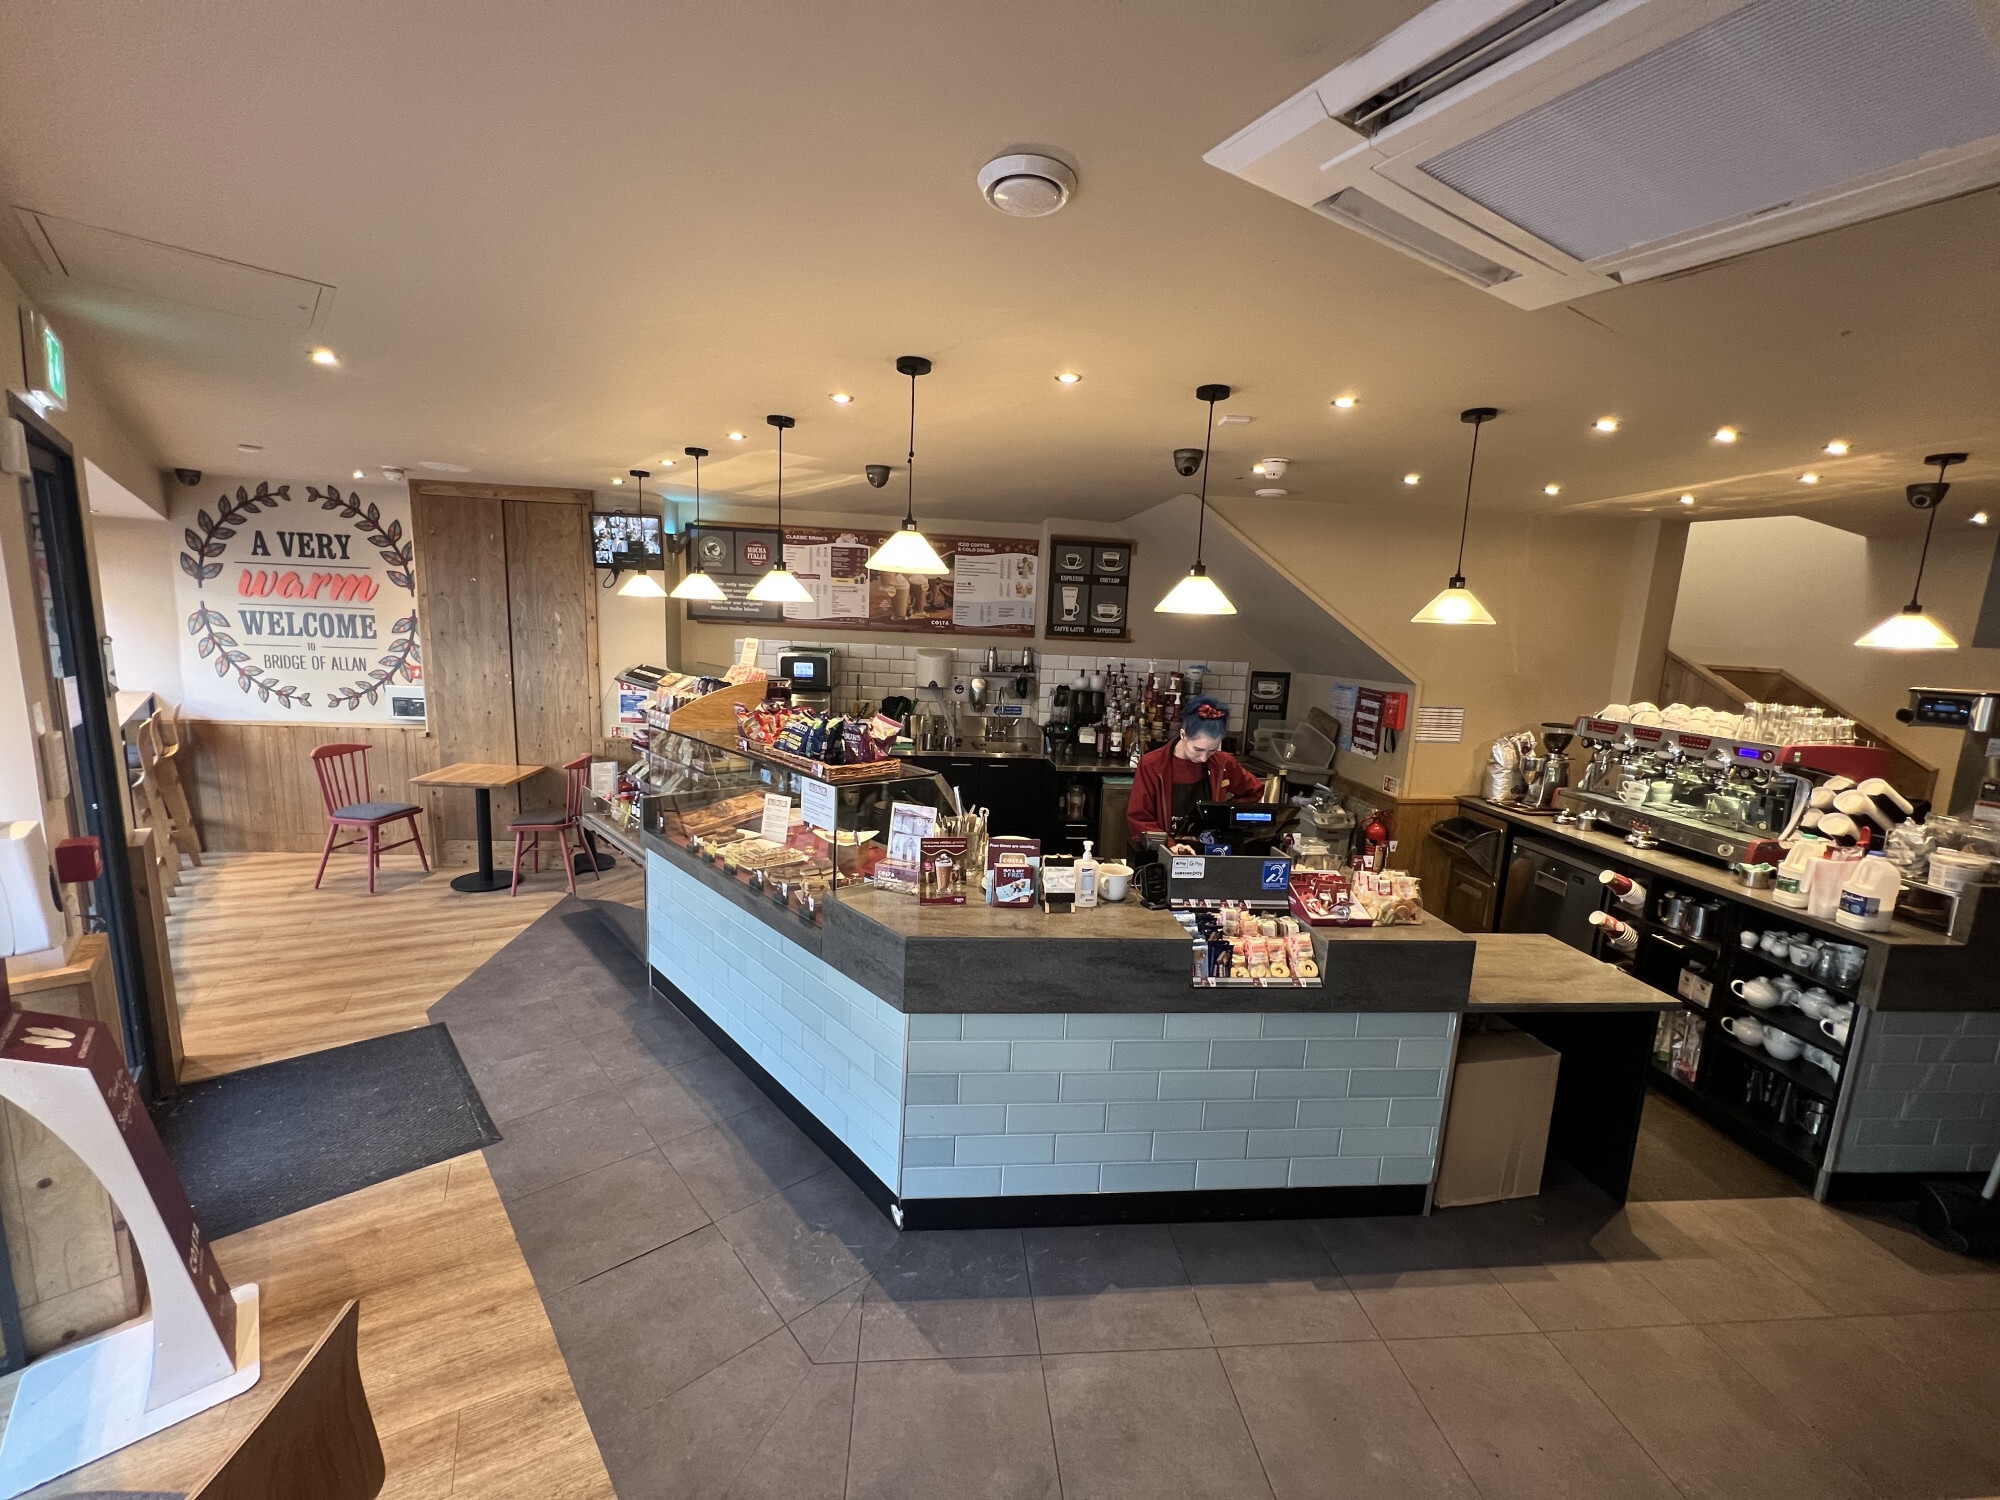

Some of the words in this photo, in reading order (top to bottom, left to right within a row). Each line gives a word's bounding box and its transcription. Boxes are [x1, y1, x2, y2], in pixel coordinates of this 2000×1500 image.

[251, 530, 271, 556] A
[277, 531, 351, 560] VERY
[747, 546, 767, 554] MOCHA
[237, 569, 379, 603] warm
[238, 610, 378, 640] WELCOME
[1093, 627, 1121, 635] CAPPUCCINO
[263, 654, 307, 671] BRIDGE
[311, 655, 326, 671] OF
[331, 656, 367, 672] ALLAN
[877, 870, 895, 878] COSTA
[189, 1222, 200, 1274] COSTA
